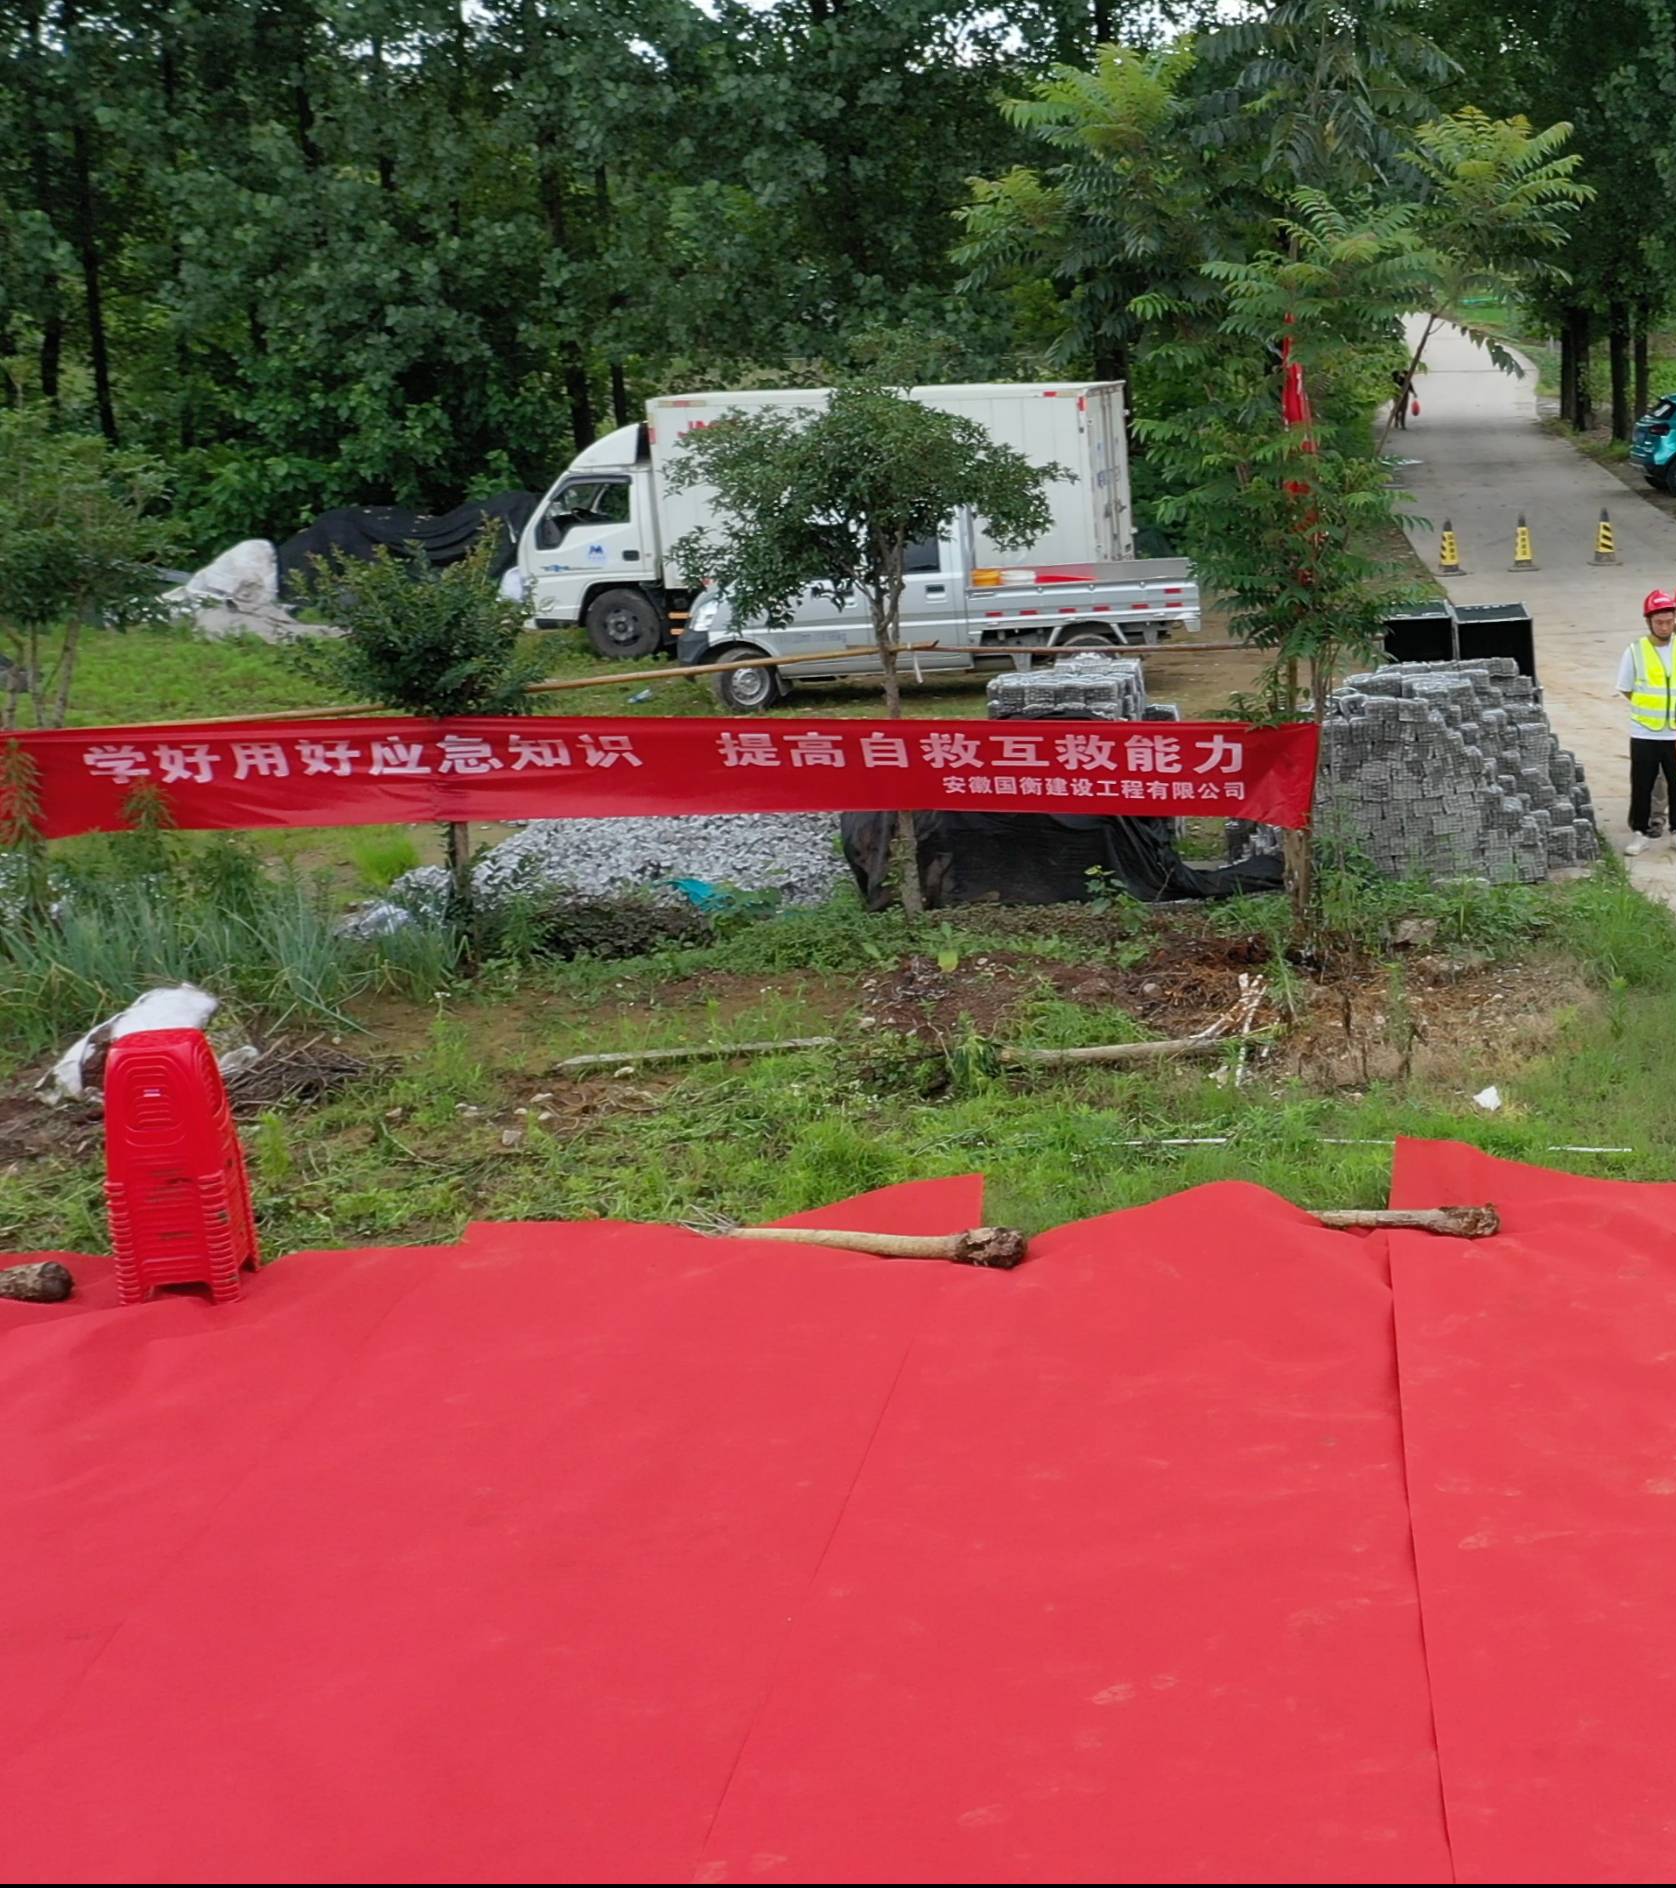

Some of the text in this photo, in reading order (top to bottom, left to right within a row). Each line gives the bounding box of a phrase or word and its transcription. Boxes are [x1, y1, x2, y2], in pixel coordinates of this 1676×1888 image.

[83, 732, 1245, 785] 学好用好应急知识 提高自救互救能力
[942, 775, 1247, 800] 安徽国衡建设工程有限公司
